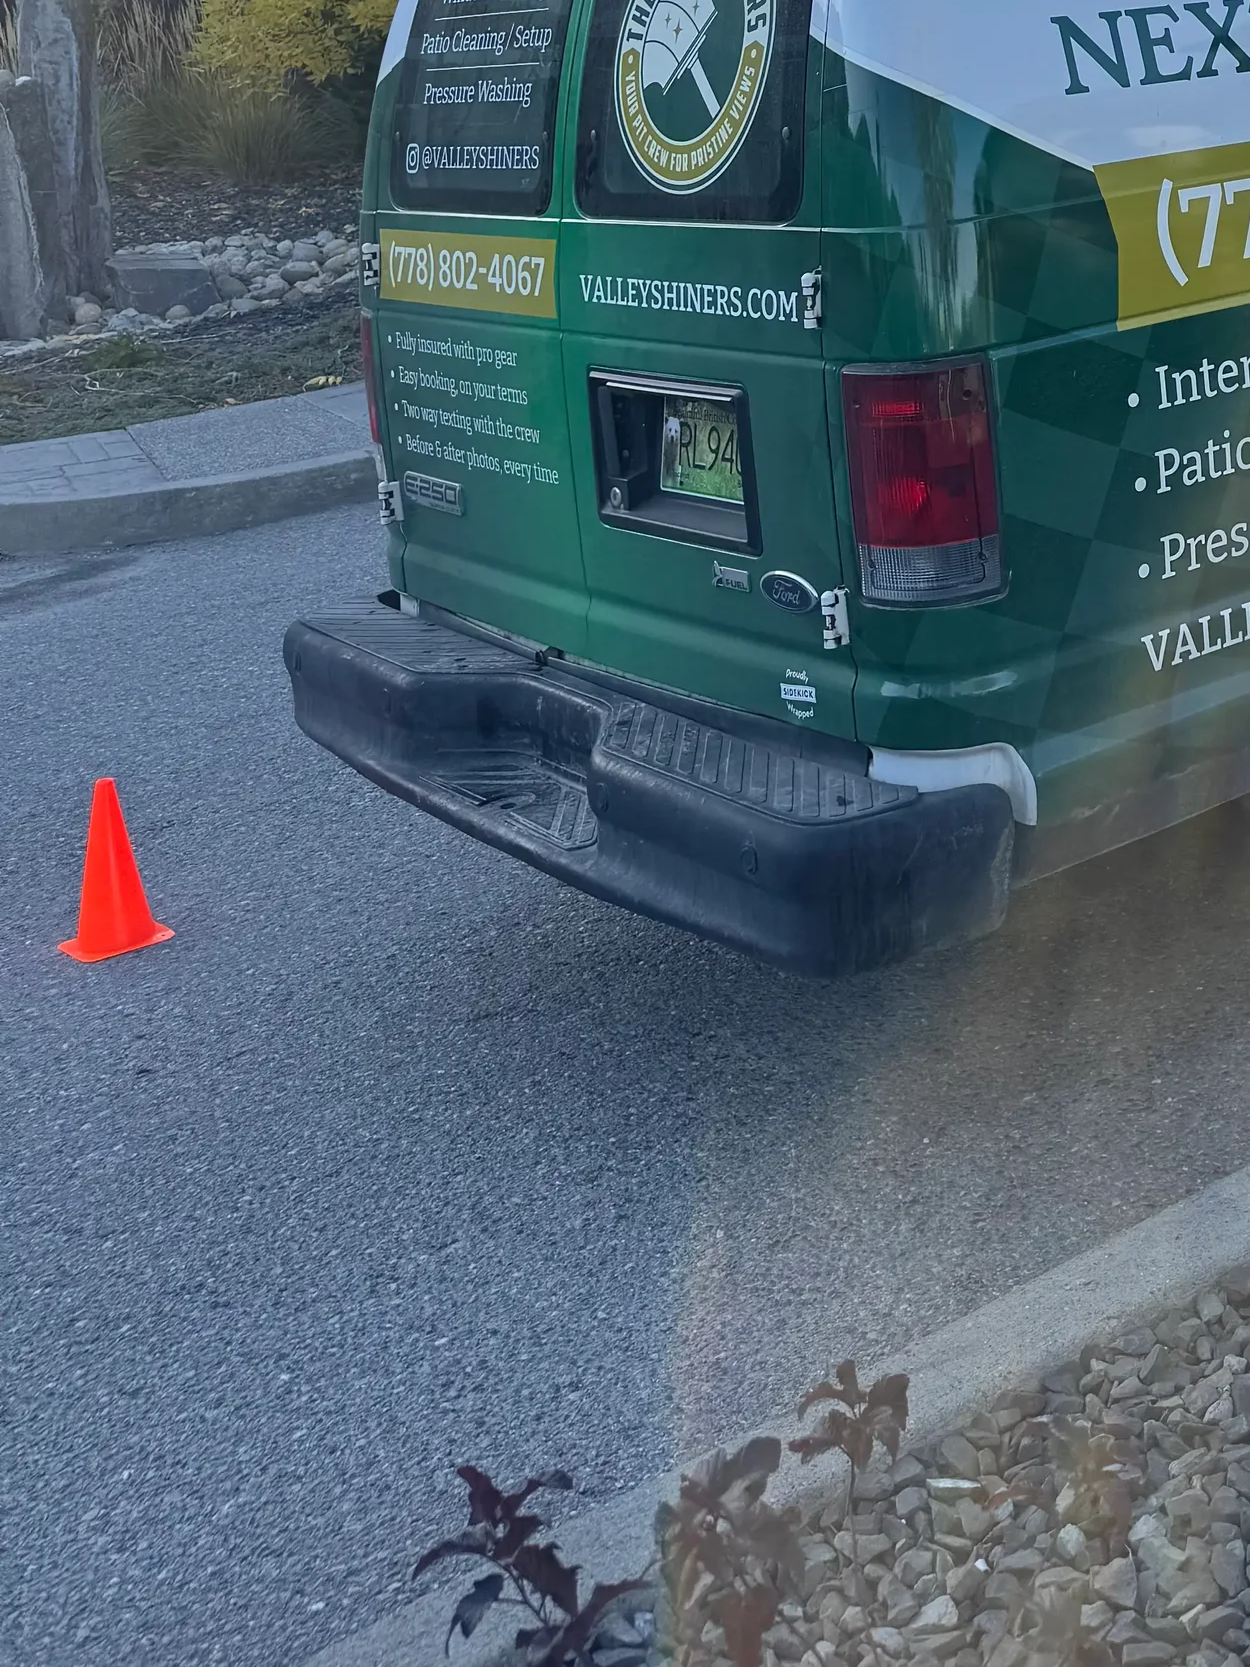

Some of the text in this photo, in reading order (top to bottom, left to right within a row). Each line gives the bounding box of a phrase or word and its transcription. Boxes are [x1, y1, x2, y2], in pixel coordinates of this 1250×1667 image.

[420, 33, 451, 55] Patio
[452, 22, 506, 56] Cleaning
[513, 25, 552, 52] Setup
[423, 77, 532, 108] Pressure Washing
[625, 65, 755, 172] YOUR PIT CREW FOR PRISTINE VIEWS
[422, 145, 540, 170] @VALLEYSHINERS
[389, 246, 545, 298] (778) 802-4067
[579, 273, 799, 324] VALLEYSHINERS.COM
[395, 331, 518, 369] Fully insured with pro gear
[398, 366, 528, 405] Easy booking, on your terms
[401, 400, 540, 444] Two way texting with the crew
[406, 434, 559, 484] Before & after photos, every time
[725, 578, 747, 590] FUEL
[773, 580, 800, 605] Ford
[783, 687, 814, 699] SIDEKICK
[786, 668, 809, 685] Proudly
[786, 701, 814, 720] Wrapped
